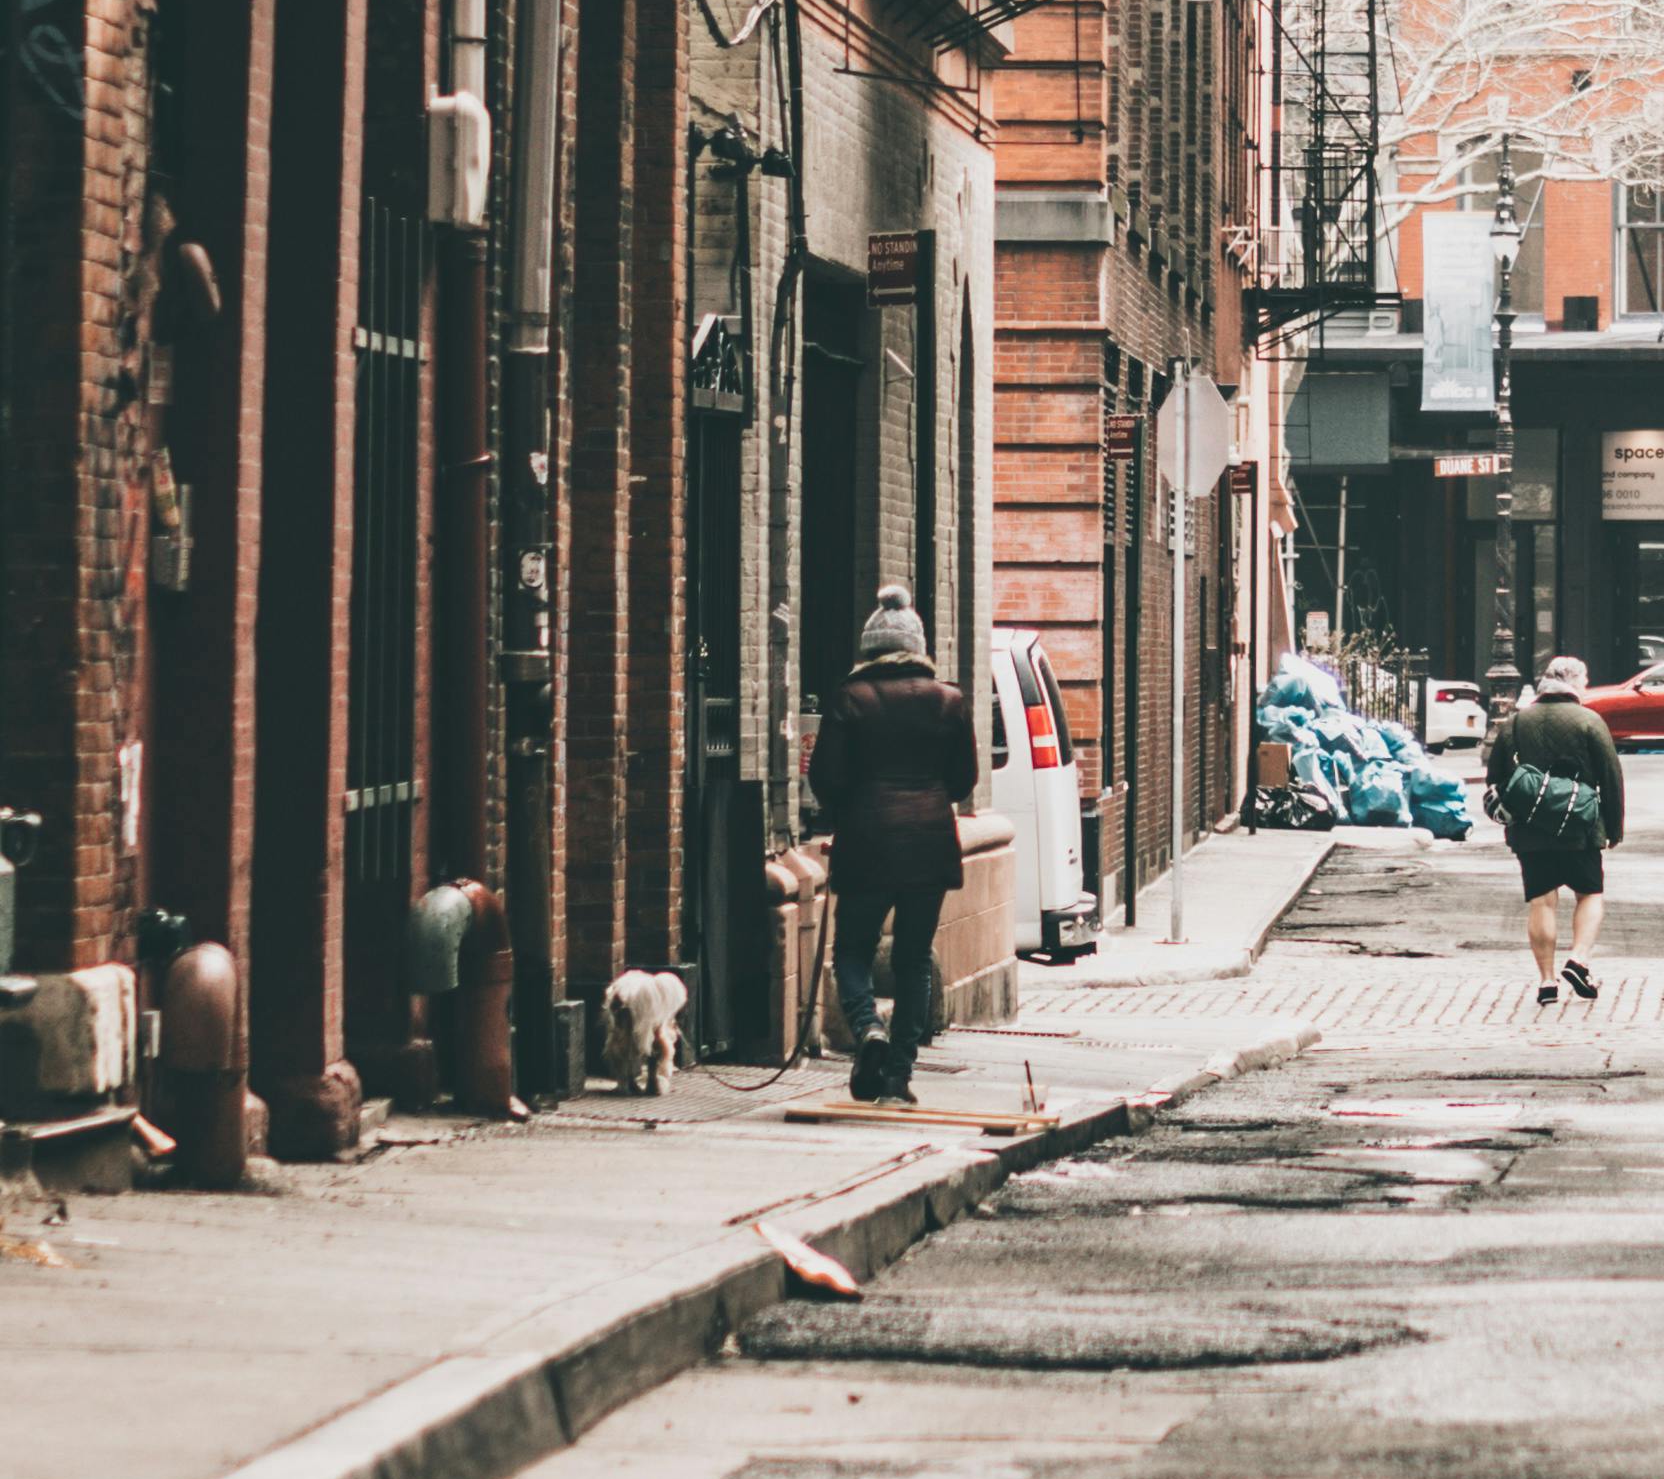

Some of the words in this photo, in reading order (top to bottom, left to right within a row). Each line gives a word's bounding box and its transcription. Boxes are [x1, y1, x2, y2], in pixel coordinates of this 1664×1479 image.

[1614, 447, 1664, 463] space
[1439, 458, 1474, 475] DUANE
[1478, 457, 1491, 474] ST
